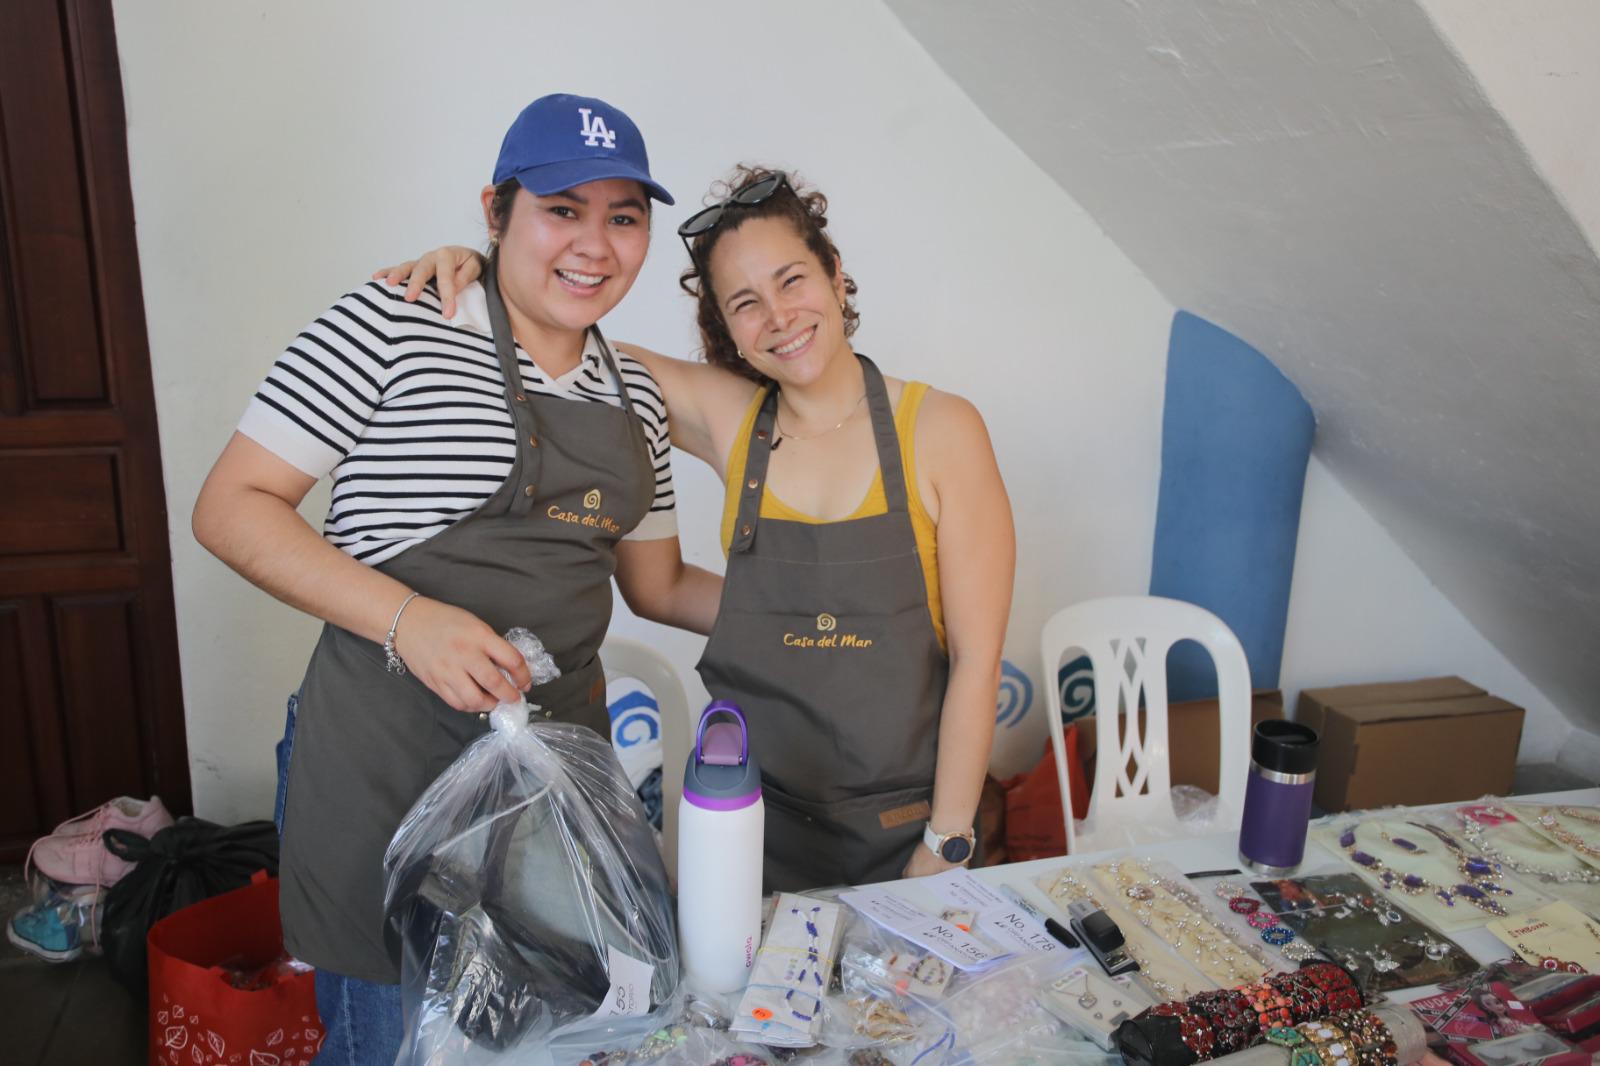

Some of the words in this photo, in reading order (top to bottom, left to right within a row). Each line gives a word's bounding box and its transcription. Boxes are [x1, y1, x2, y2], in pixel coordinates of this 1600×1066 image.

[578, 107, 616, 149] LA
[547, 505, 579, 523] Casa
[581, 513, 600, 528] del
[783, 633, 814, 648] Casa
[817, 634, 837, 648] del
[840, 634, 873, 648] Mar
[930, 925, 954, 941] No.
[1004, 913, 1025, 932] No.
[1030, 933, 1056, 951] 178
